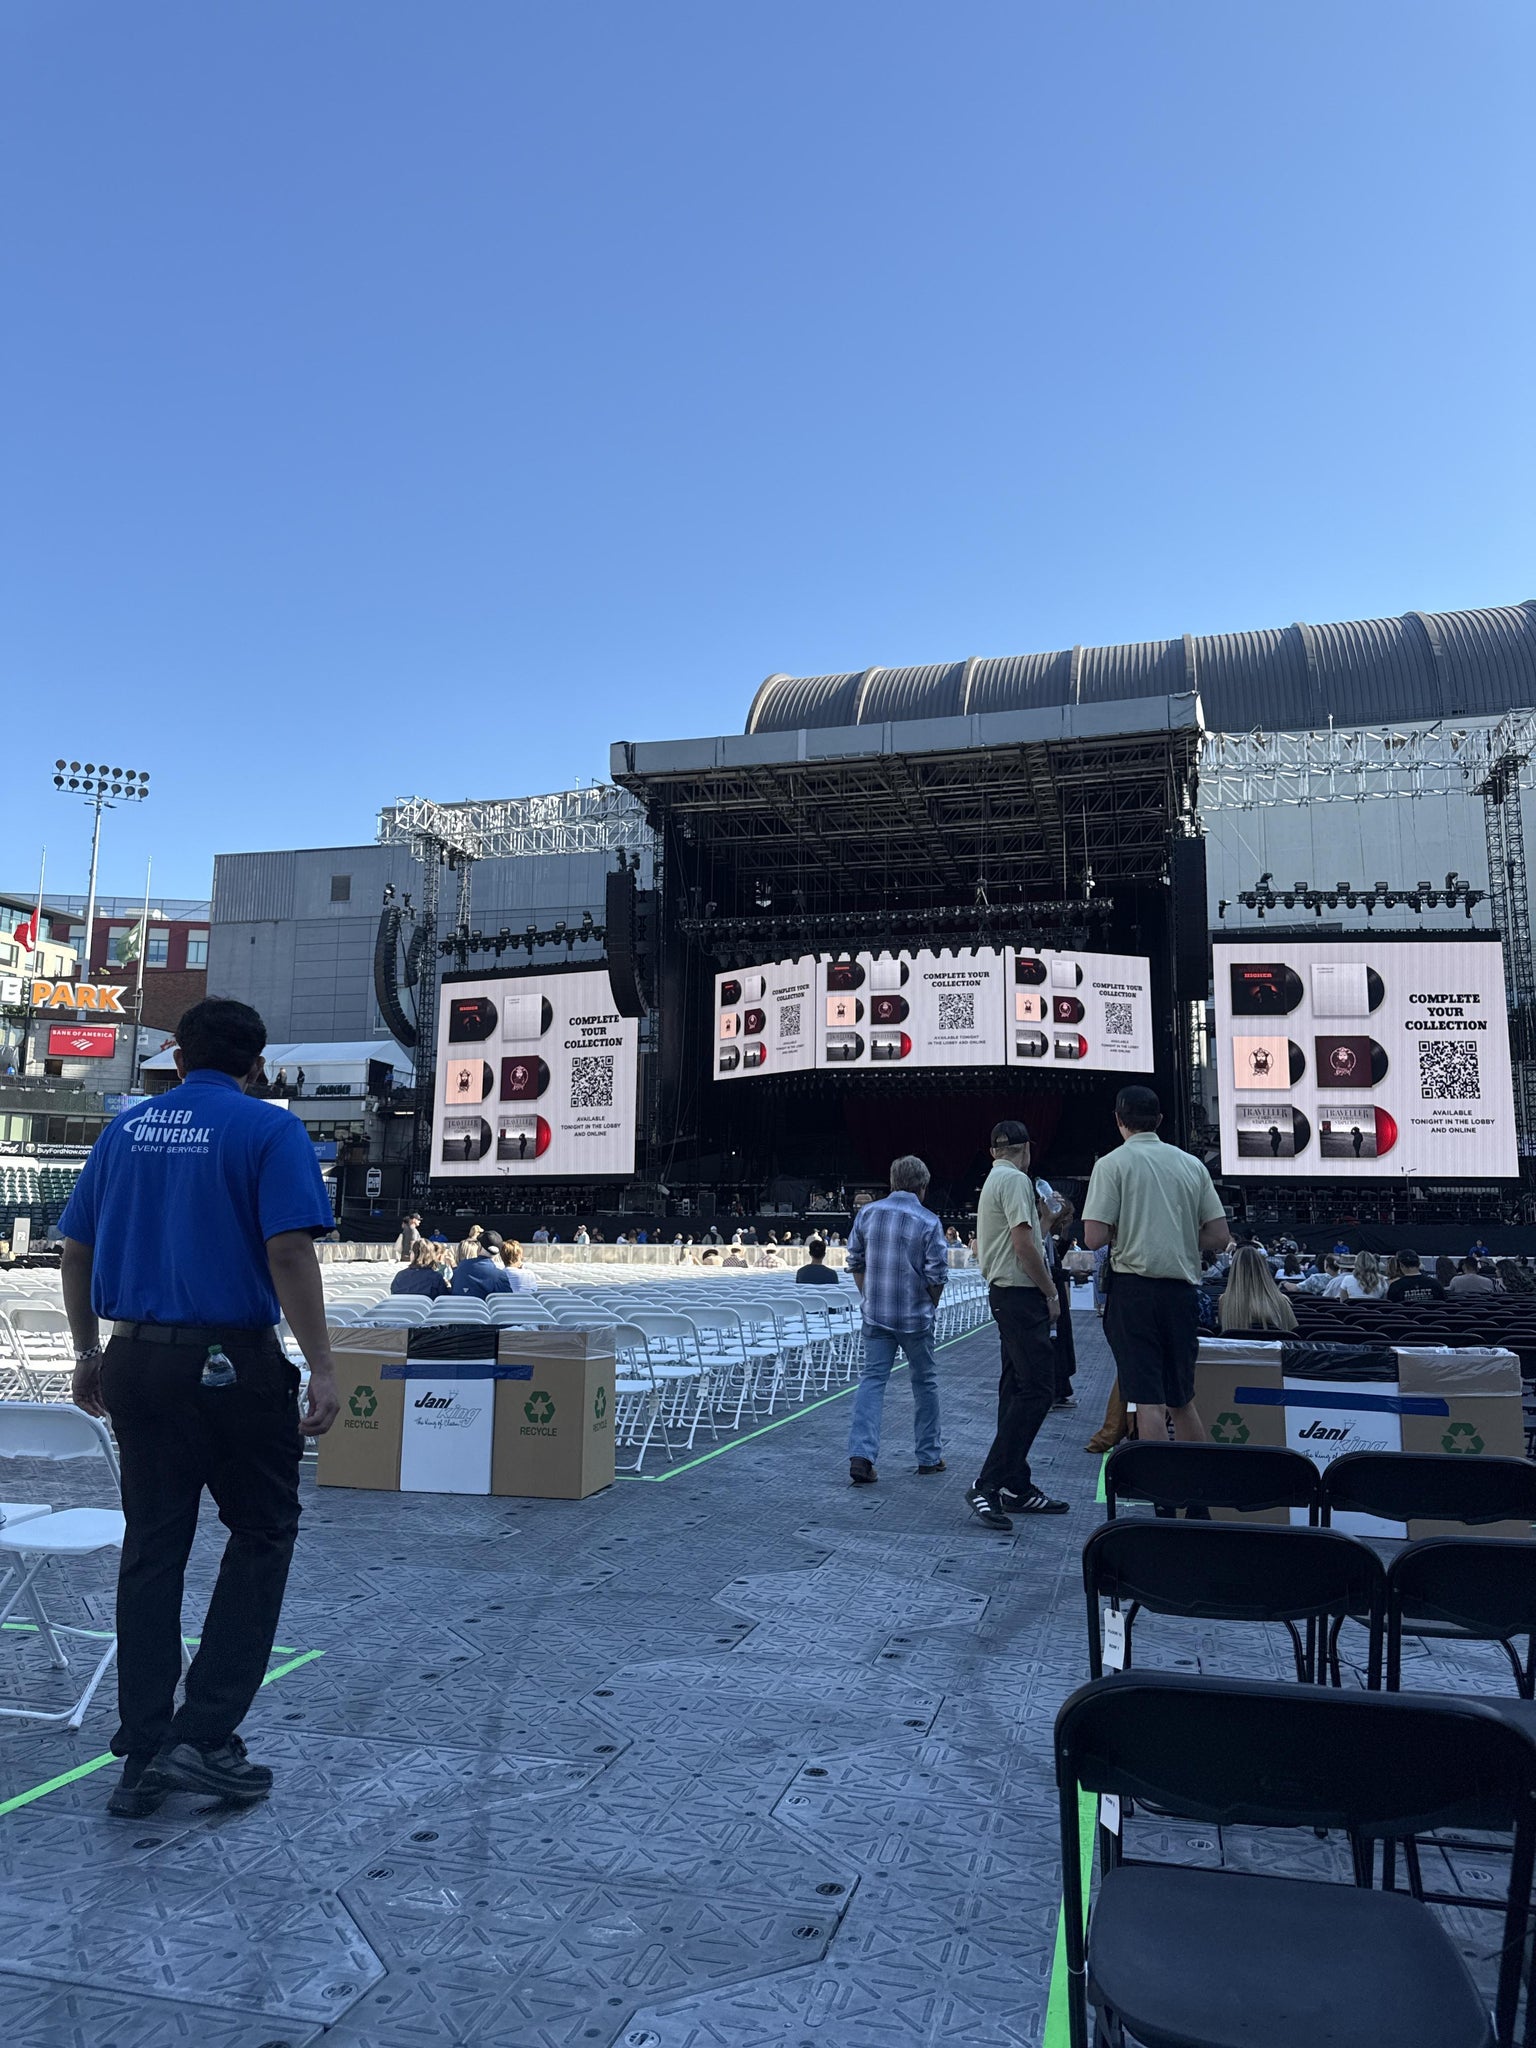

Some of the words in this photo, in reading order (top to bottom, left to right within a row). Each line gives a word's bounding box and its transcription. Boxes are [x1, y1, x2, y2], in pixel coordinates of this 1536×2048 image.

[932, 980, 981, 988] COLLECTION
[30, 981, 124, 1012] PARK
[1409, 994, 1480, 1003] COMPLETE
[1427, 1007, 1464, 1016] YOUR
[569, 1015, 620, 1026] COMPLETE
[1405, 1021, 1487, 1030] COLLECTION
[581, 1027, 606, 1036] YOUR
[564, 1038, 623, 1049] COLLECTION
[141, 1107, 193, 1124] ALLIED
[134, 1124, 210, 1143] UNIVERSAL
[131, 1144, 165, 1152] EVENT
[414, 1392, 454, 1409] Jani
[344, 1419, 379, 1429] RECYCLE
[520, 1426, 558, 1436] RECYCLE
[1299, 1421, 1350, 1440] Jani
